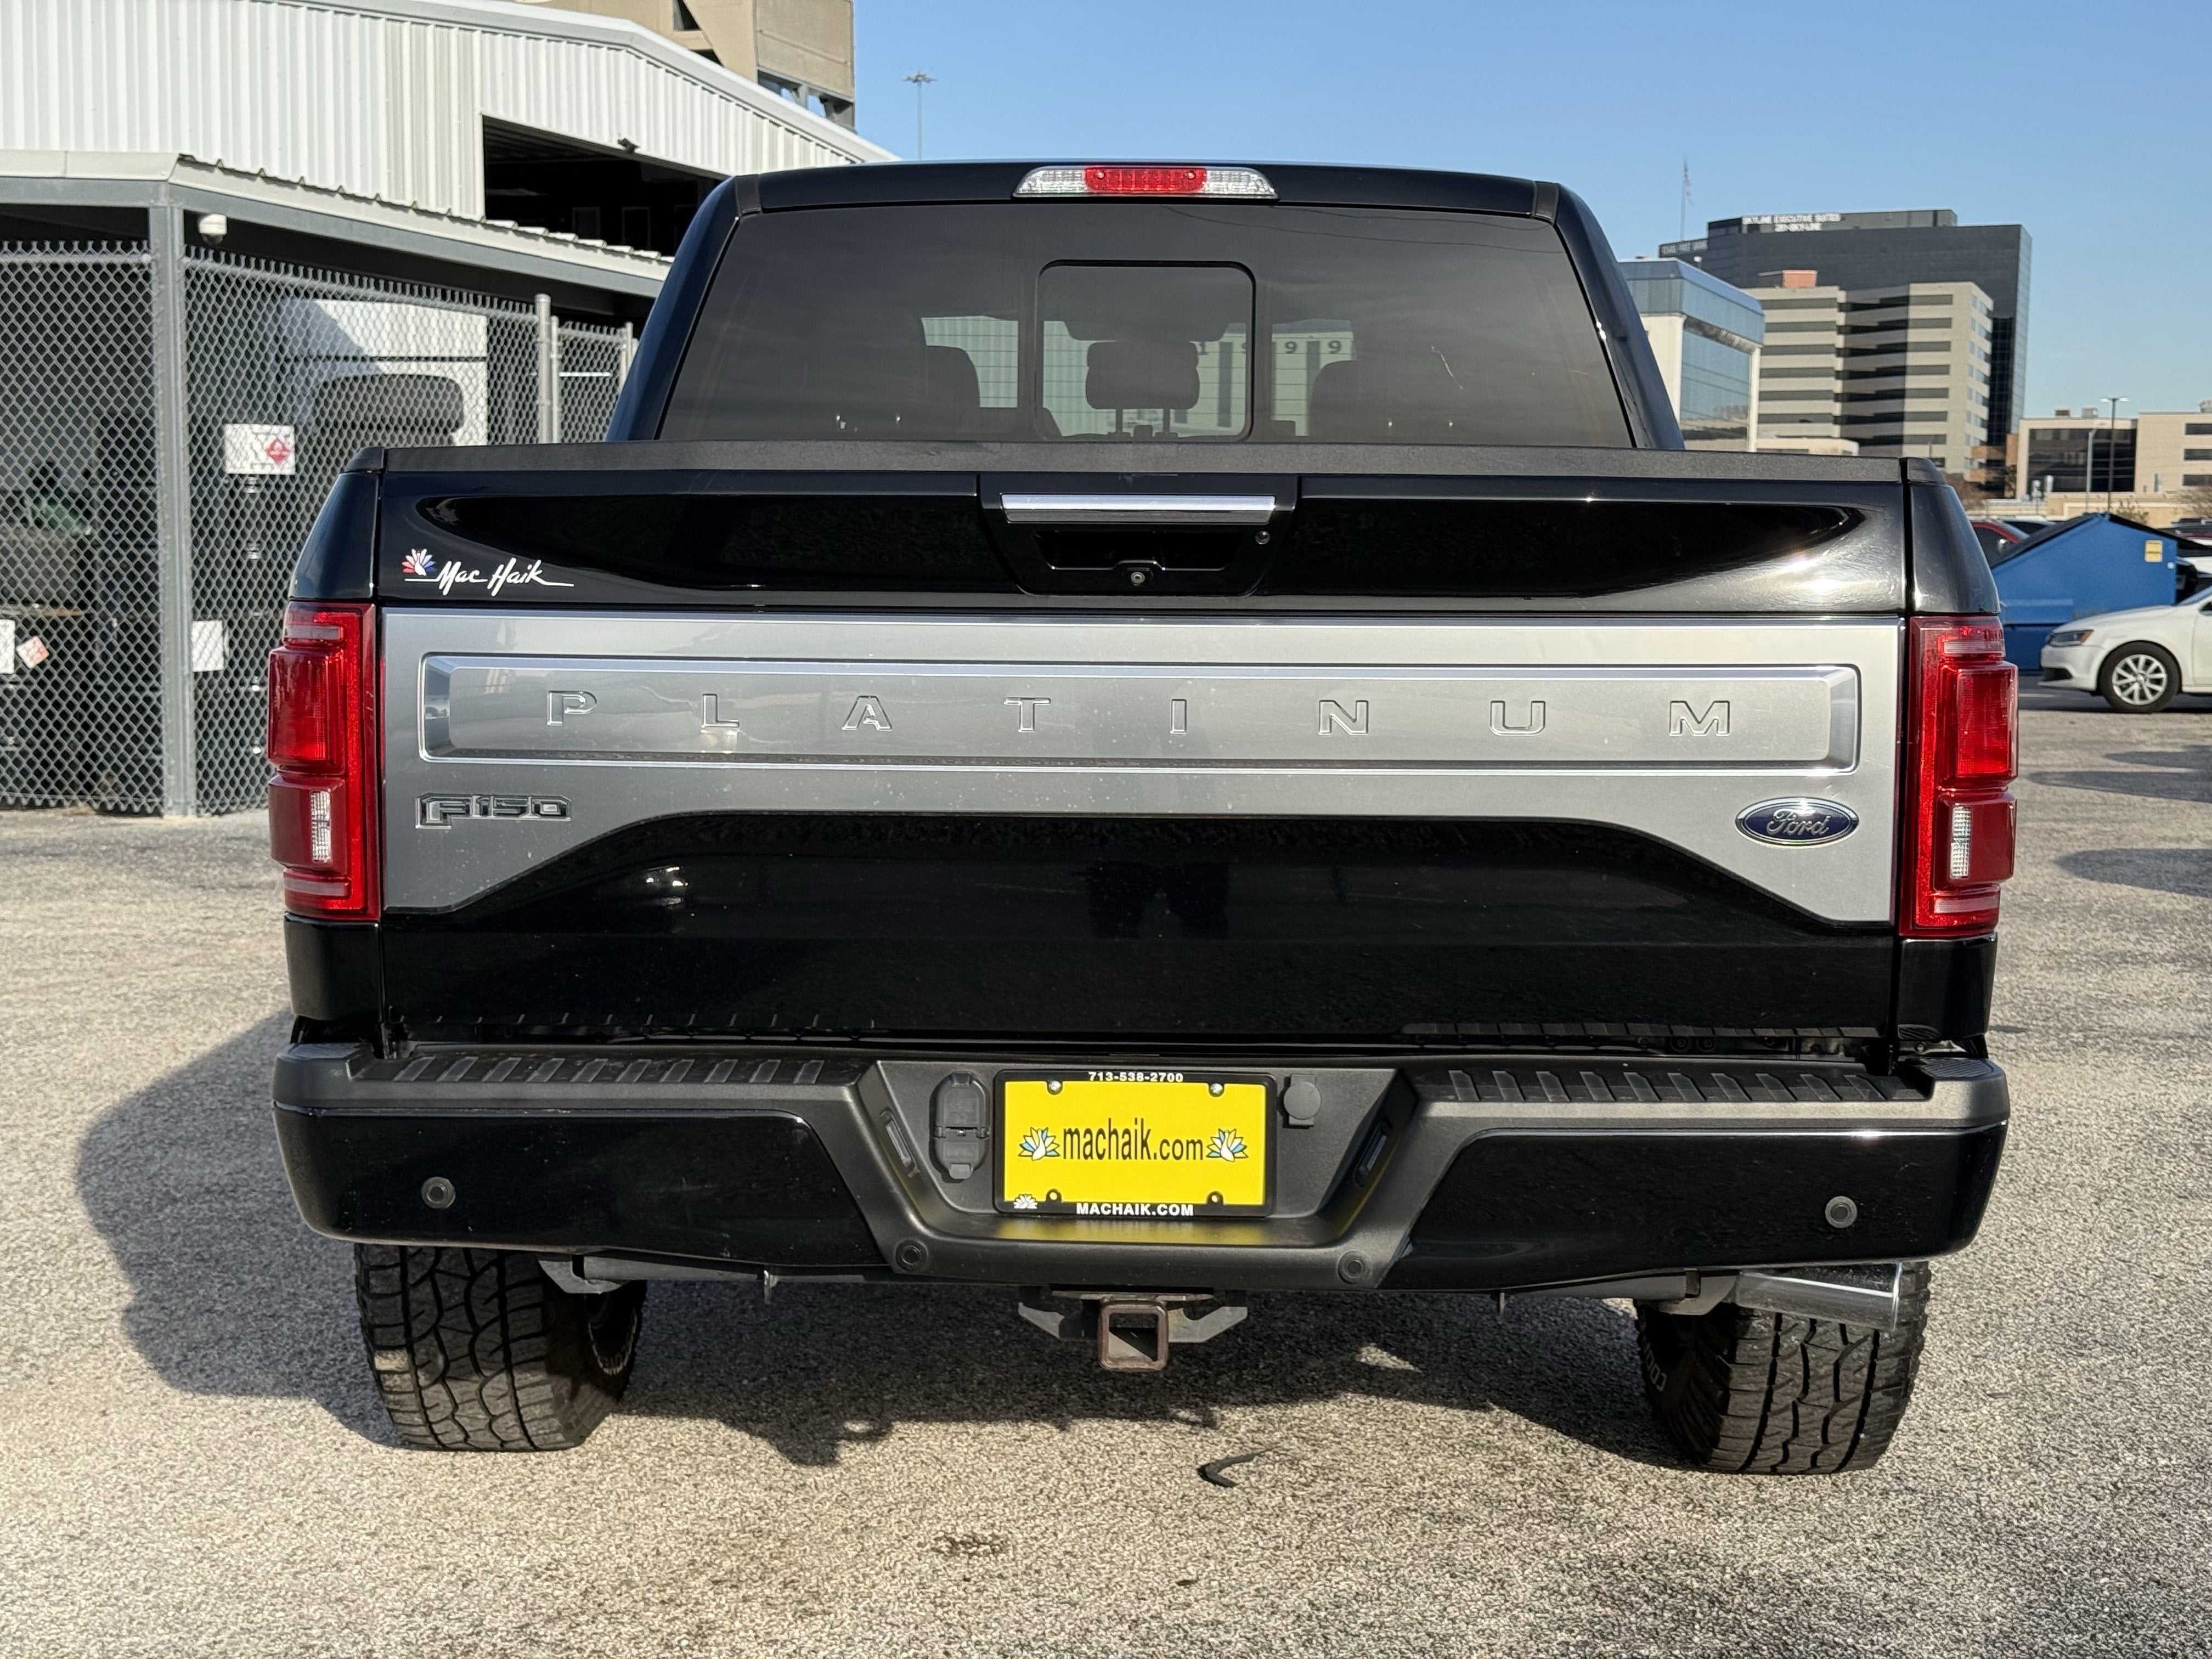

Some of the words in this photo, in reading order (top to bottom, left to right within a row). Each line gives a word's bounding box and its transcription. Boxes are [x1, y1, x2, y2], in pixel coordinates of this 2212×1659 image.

[422, 561, 488, 596] Mac
[487, 557, 565, 597] Haik
[547, 690, 1730, 736] PLATINUM
[1766, 808, 1831, 836] Ford
[1088, 1071, 1184, 1083] 713-538-2700
[1063, 1117, 1204, 1161] machaik.com
[1076, 1203, 1194, 1216] MACHAIK.COM
